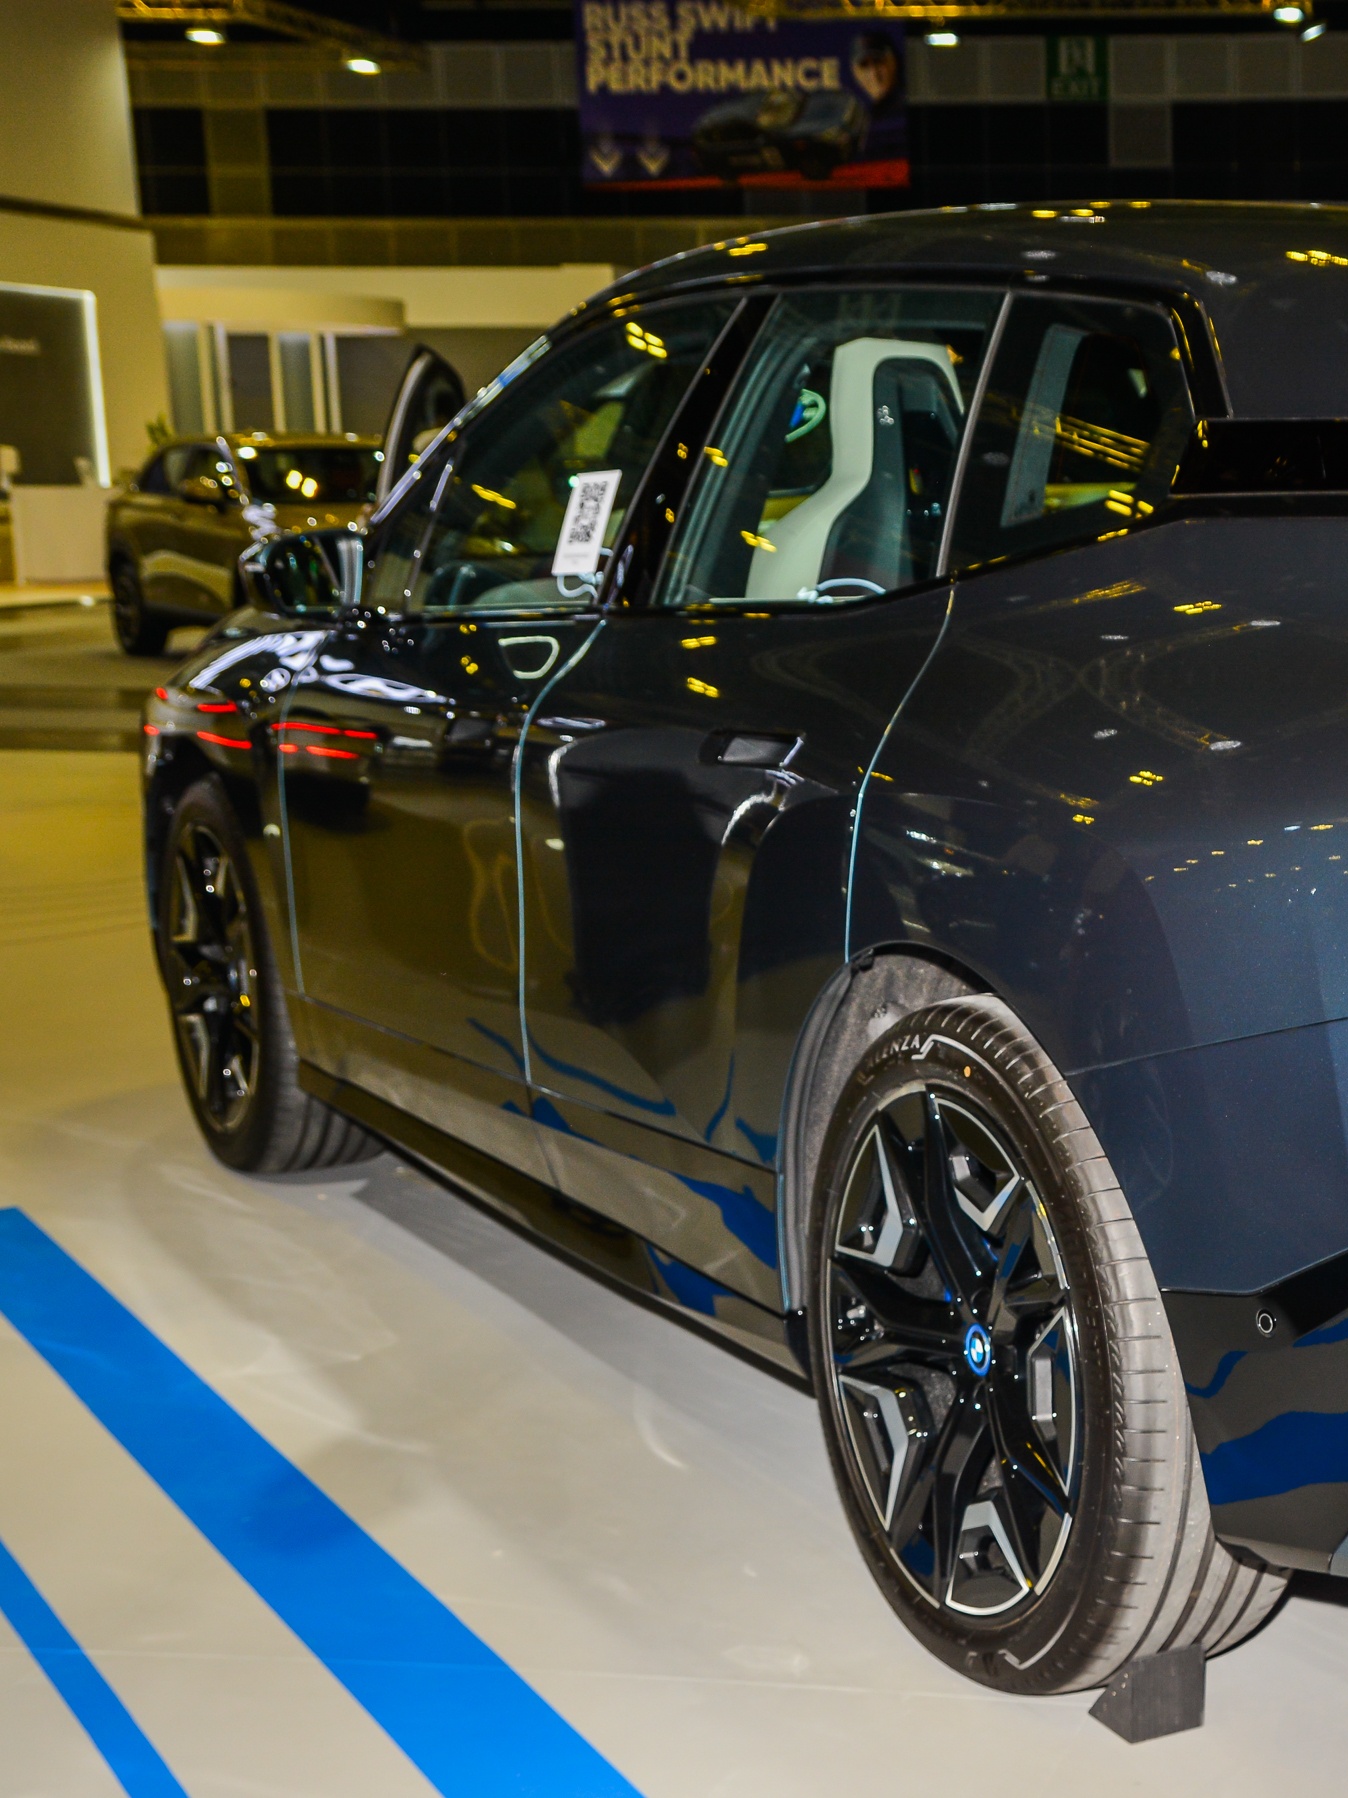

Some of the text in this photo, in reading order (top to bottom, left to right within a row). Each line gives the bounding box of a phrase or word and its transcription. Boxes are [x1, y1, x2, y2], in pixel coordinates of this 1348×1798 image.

[583, 0, 670, 34] RUSS
[586, 29, 692, 62] STUNT
[586, 56, 841, 93] PERFORMANCE
